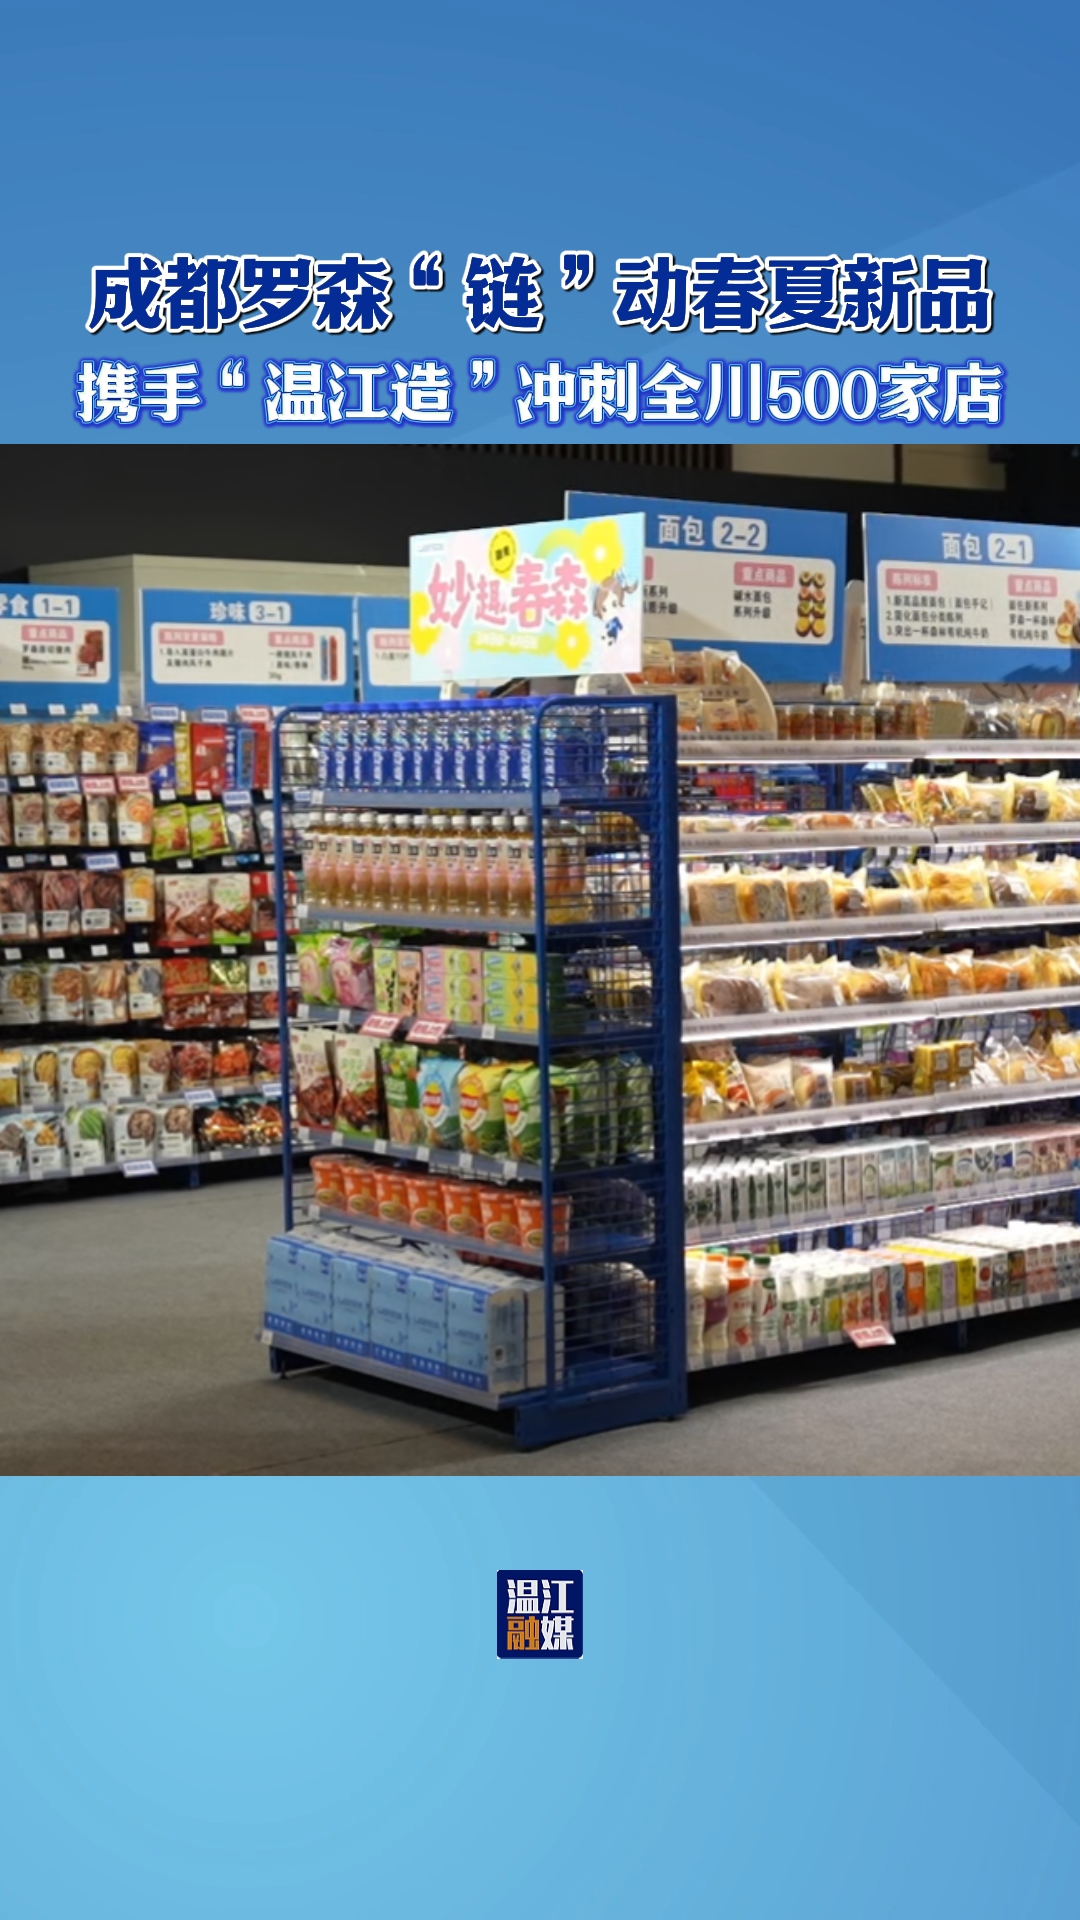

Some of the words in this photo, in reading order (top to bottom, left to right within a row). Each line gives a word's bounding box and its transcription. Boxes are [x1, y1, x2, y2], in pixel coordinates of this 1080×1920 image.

[657, 514, 705, 546] 面包
[720, 521, 761, 547] 2-2
[941, 532, 983, 560] 面包
[994, 537, 1027, 561] 2-1
[742, 566, 788, 584] 重点商品
[643, 585, 669, 599] 系列
[42, 598, 73, 615] 1-1
[209, 601, 246, 622] 珍味
[255, 604, 285, 621] 3-1
[643, 601, 678, 615] 质升级
